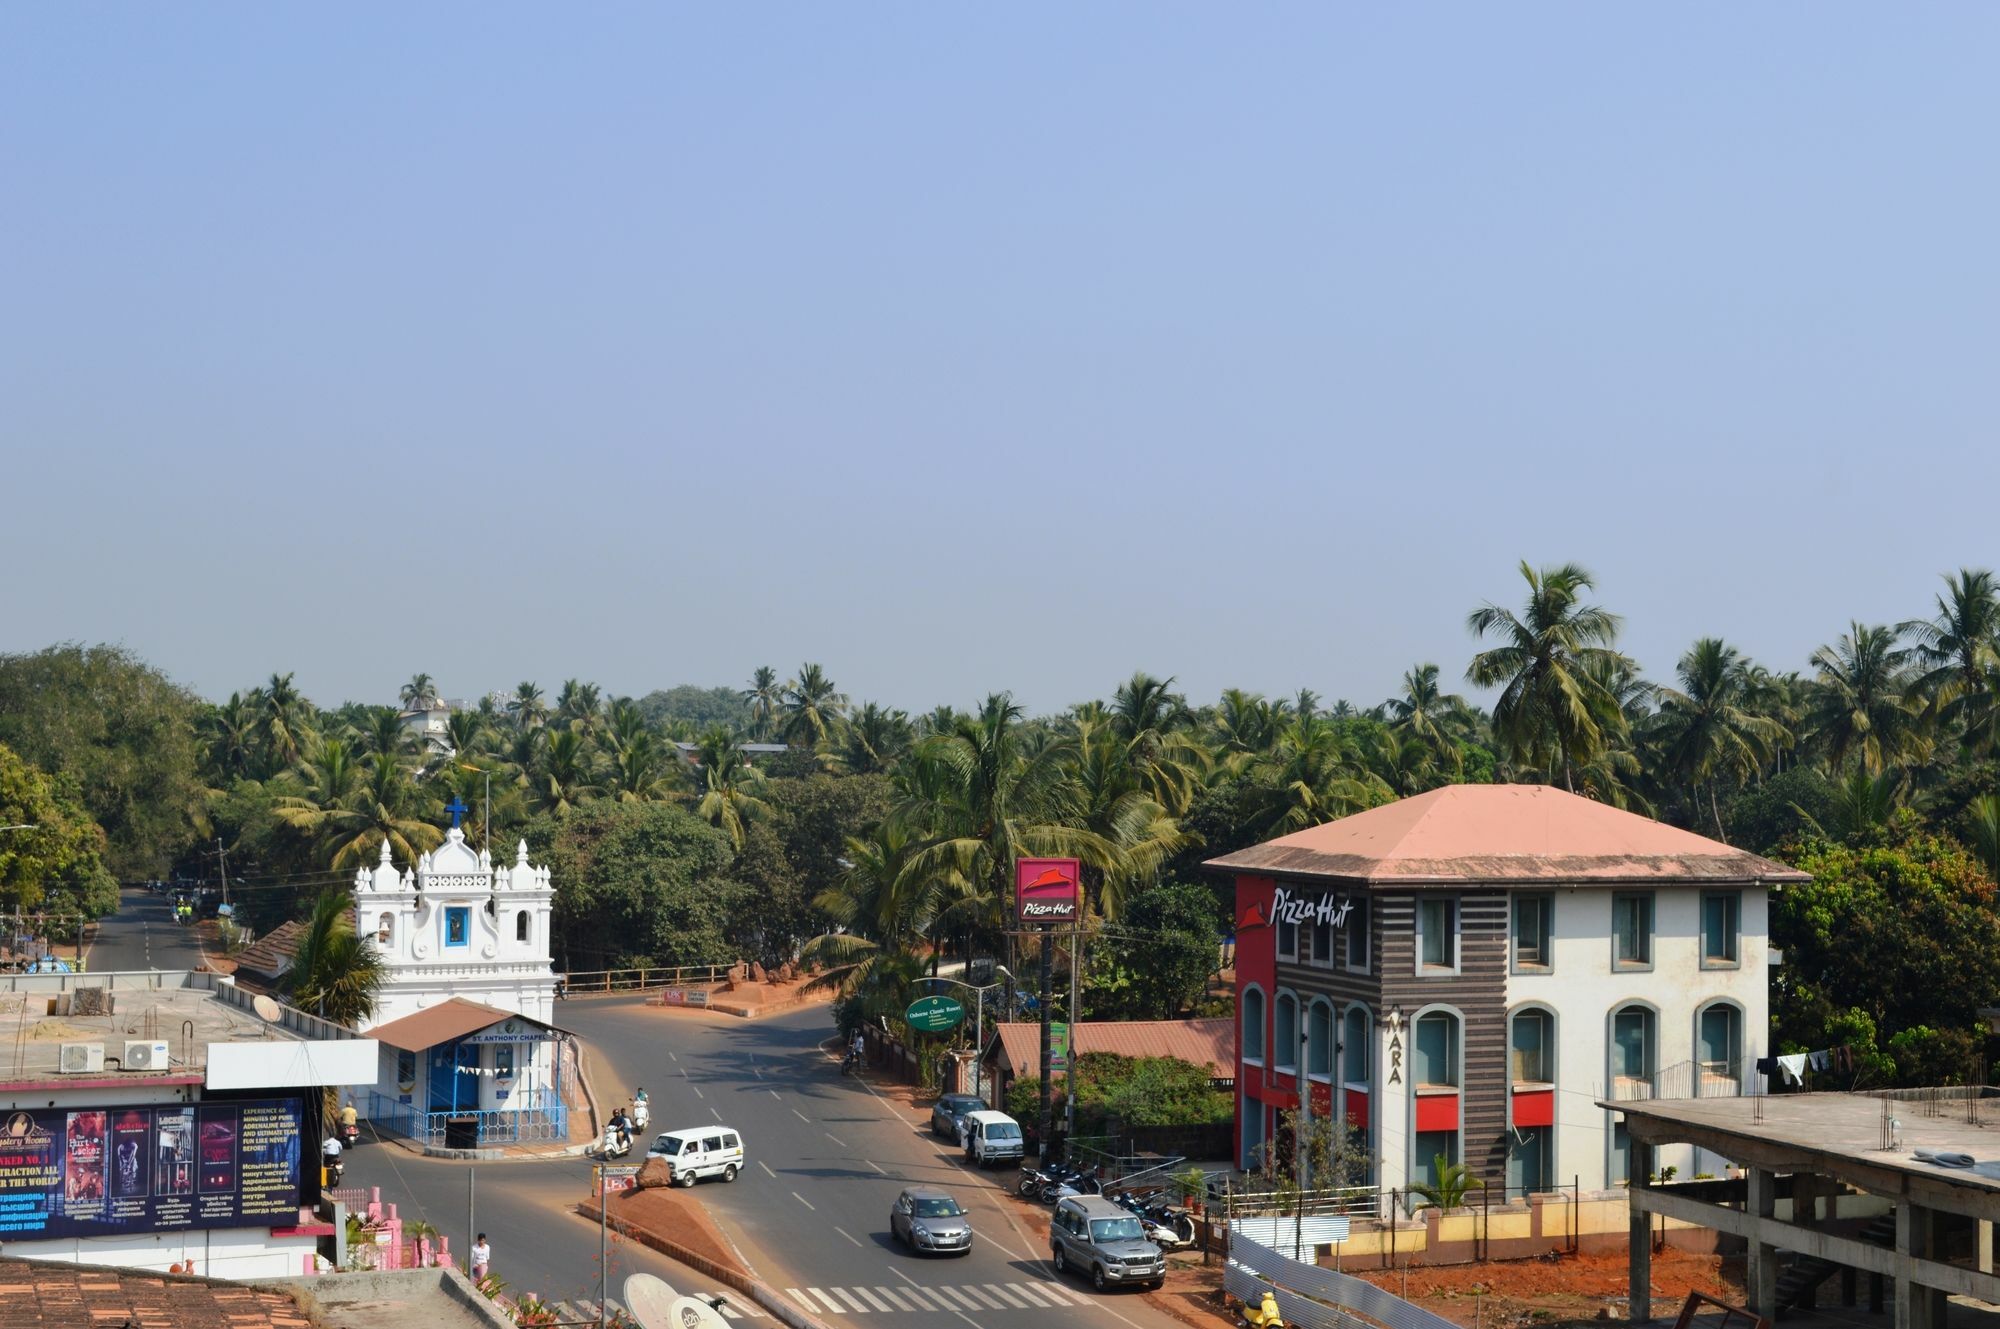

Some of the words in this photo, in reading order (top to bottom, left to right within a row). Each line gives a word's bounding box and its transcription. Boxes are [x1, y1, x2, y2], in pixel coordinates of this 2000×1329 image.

[1023, 903, 1052, 915] Pizza
[1053, 903, 1075, 914] Hut
[1270, 887, 1315, 925] Pizza
[1316, 891, 1354, 928] Hut
[1387, 1004, 1404, 1085] AMARA
[243, 1122, 279, 1130] ADRENALINE
[257, 1129, 283, 1137] ULTIMATE
[283, 1128, 299, 1136] TEAM
[25, 1136, 51, 1145] Rooms
[69, 1138, 90, 1148] Hurt
[71, 1146, 101, 1156] Locker
[26, 1155, 41, 1165] NO.
[43, 1166, 58, 1175] ALL
[242, 1171, 263, 1179] минут
[9, 1178, 26, 1187] THE
[242, 1207, 269, 1215] никогда
[24, 1221, 45, 1231] мира
[683, 1310, 700, 1327] d2h
